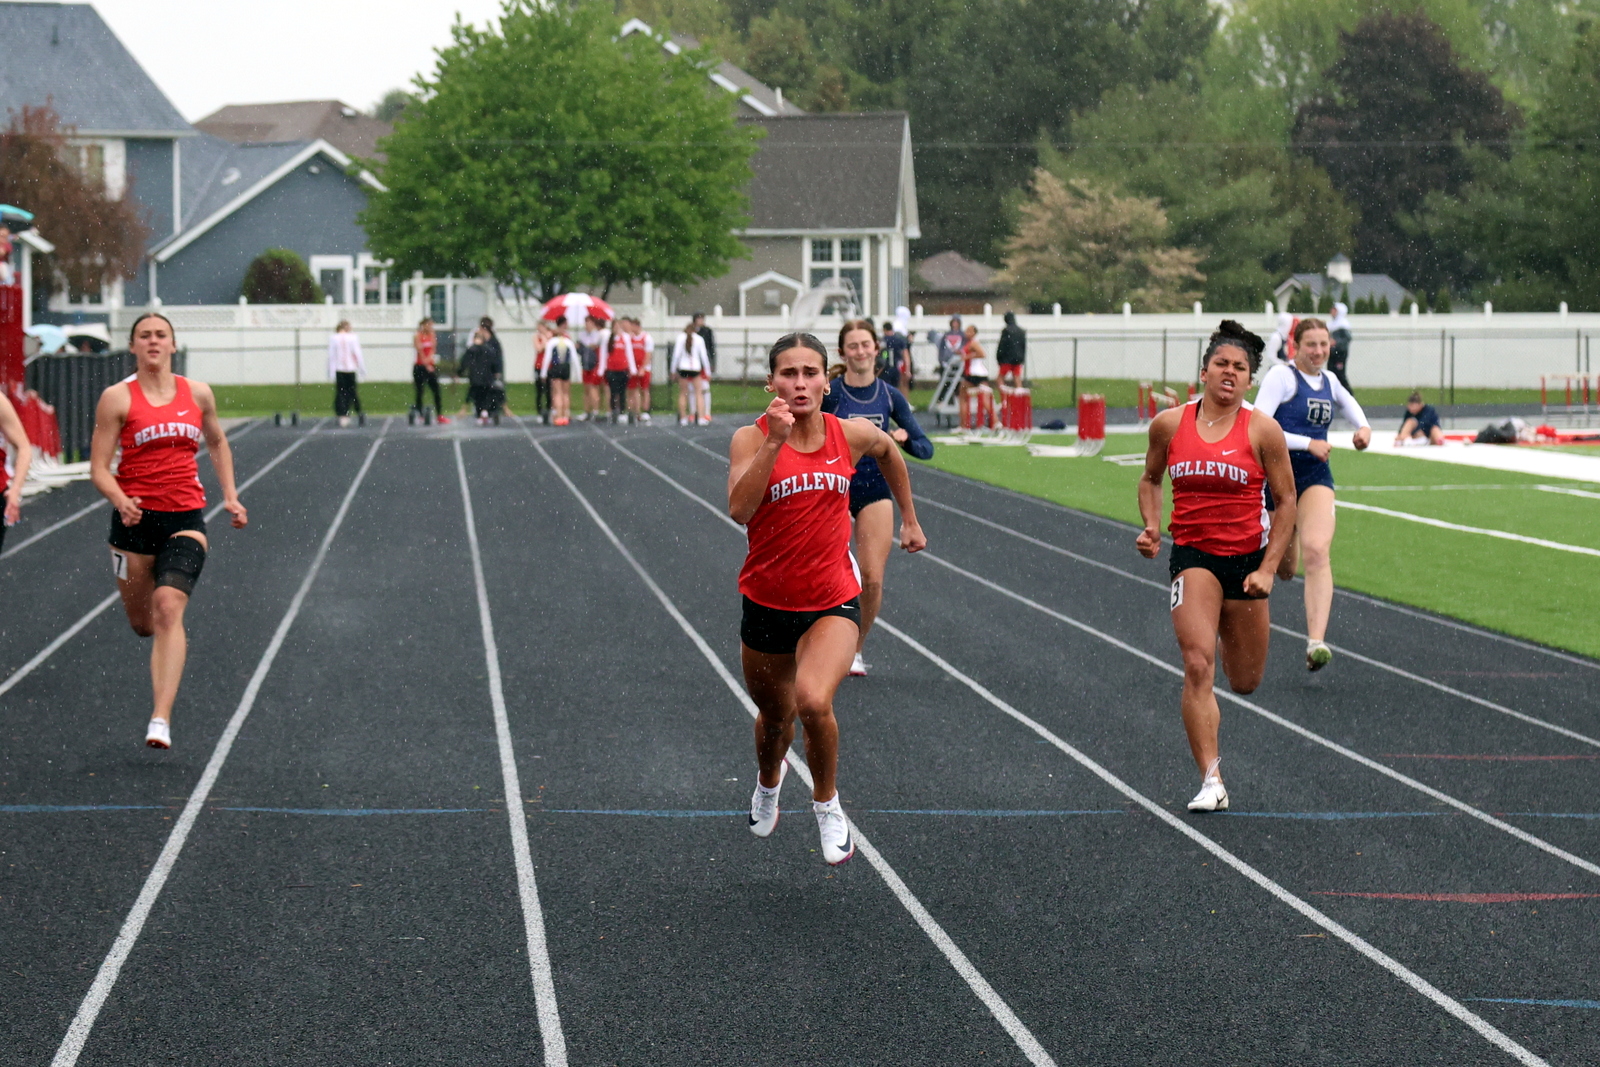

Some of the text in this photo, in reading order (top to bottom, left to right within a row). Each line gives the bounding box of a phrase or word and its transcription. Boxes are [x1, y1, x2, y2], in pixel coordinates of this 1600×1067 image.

[1170, 460, 1249, 485] BELLEVUE
[114, 553, 122, 575] 7
[1171, 580, 1180, 607] 3
